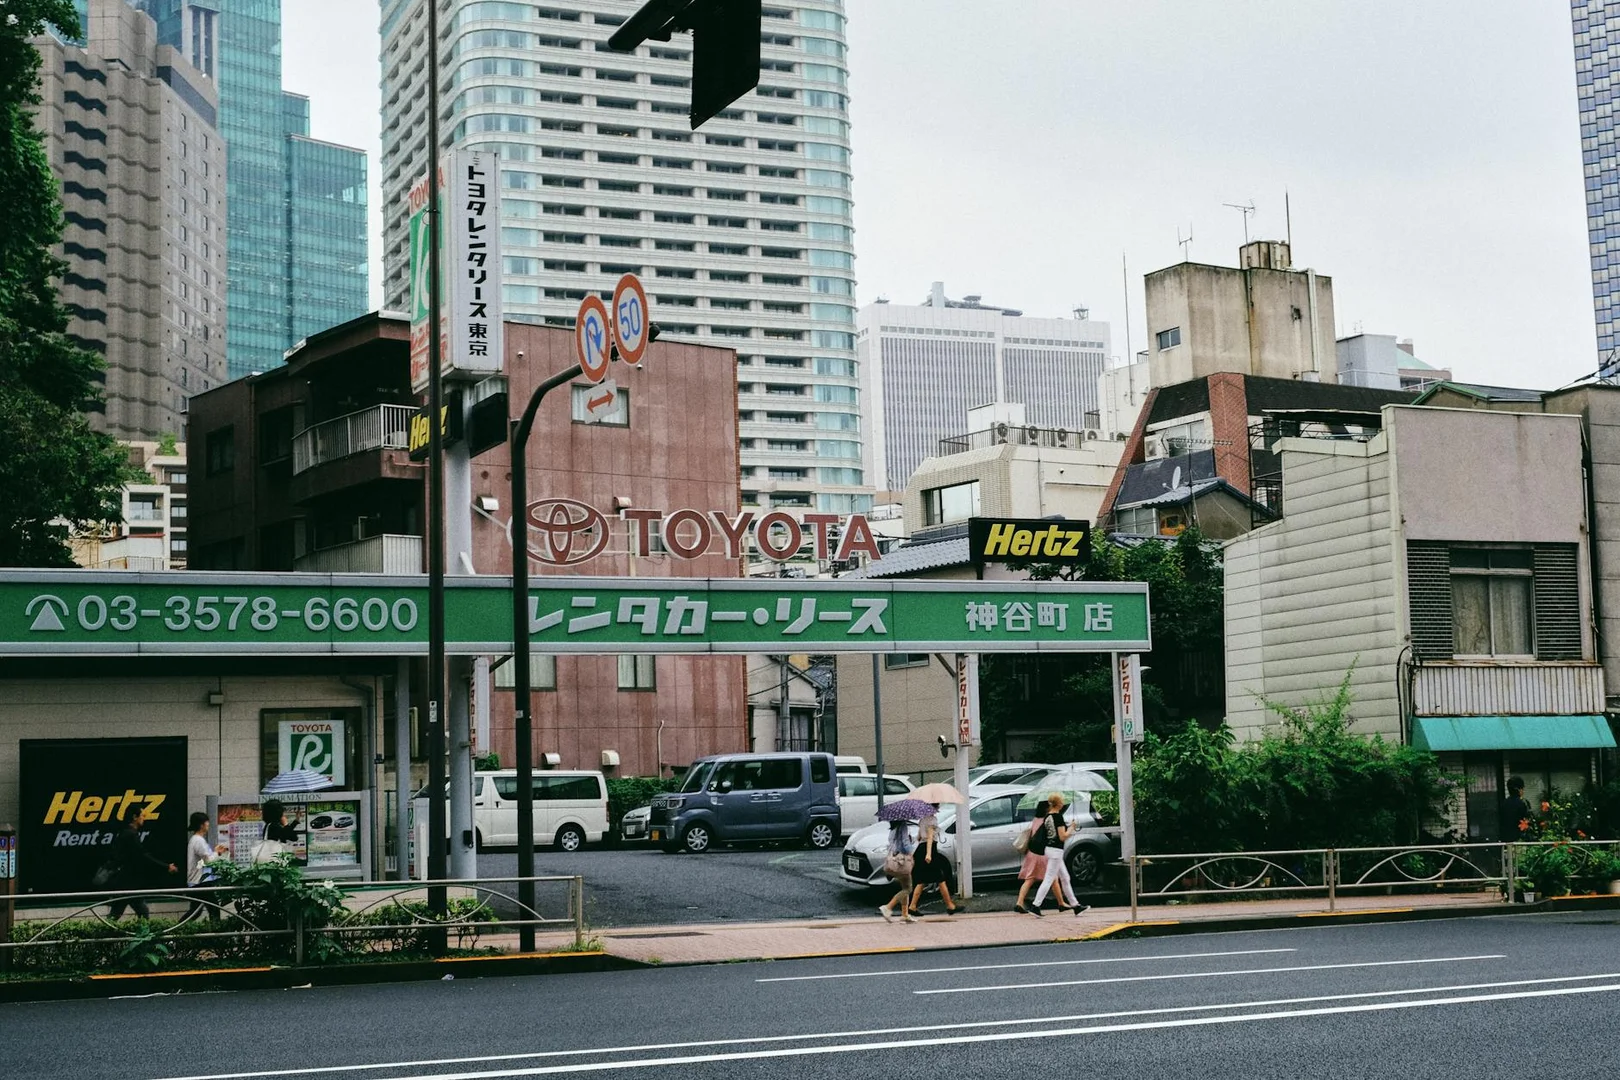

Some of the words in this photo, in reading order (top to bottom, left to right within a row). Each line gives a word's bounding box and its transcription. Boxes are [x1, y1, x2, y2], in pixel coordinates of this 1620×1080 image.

[466, 165, 488, 356] トヨタレンタリース東京
[619, 297, 641, 341] 50
[620, 508, 882, 562] TOYOTA
[984, 523, 1084, 557] Hertz
[77, 595, 418, 631] 03-3578-6600
[528, 596, 888, 634] レンタカー・リース
[1121, 659, 1131, 715] レンタカー
[291, 724, 332, 732] TOYOTA
[43, 789, 167, 824] Hertz
[53, 830, 100, 847] Rent
[101, 832, 114, 844] a
